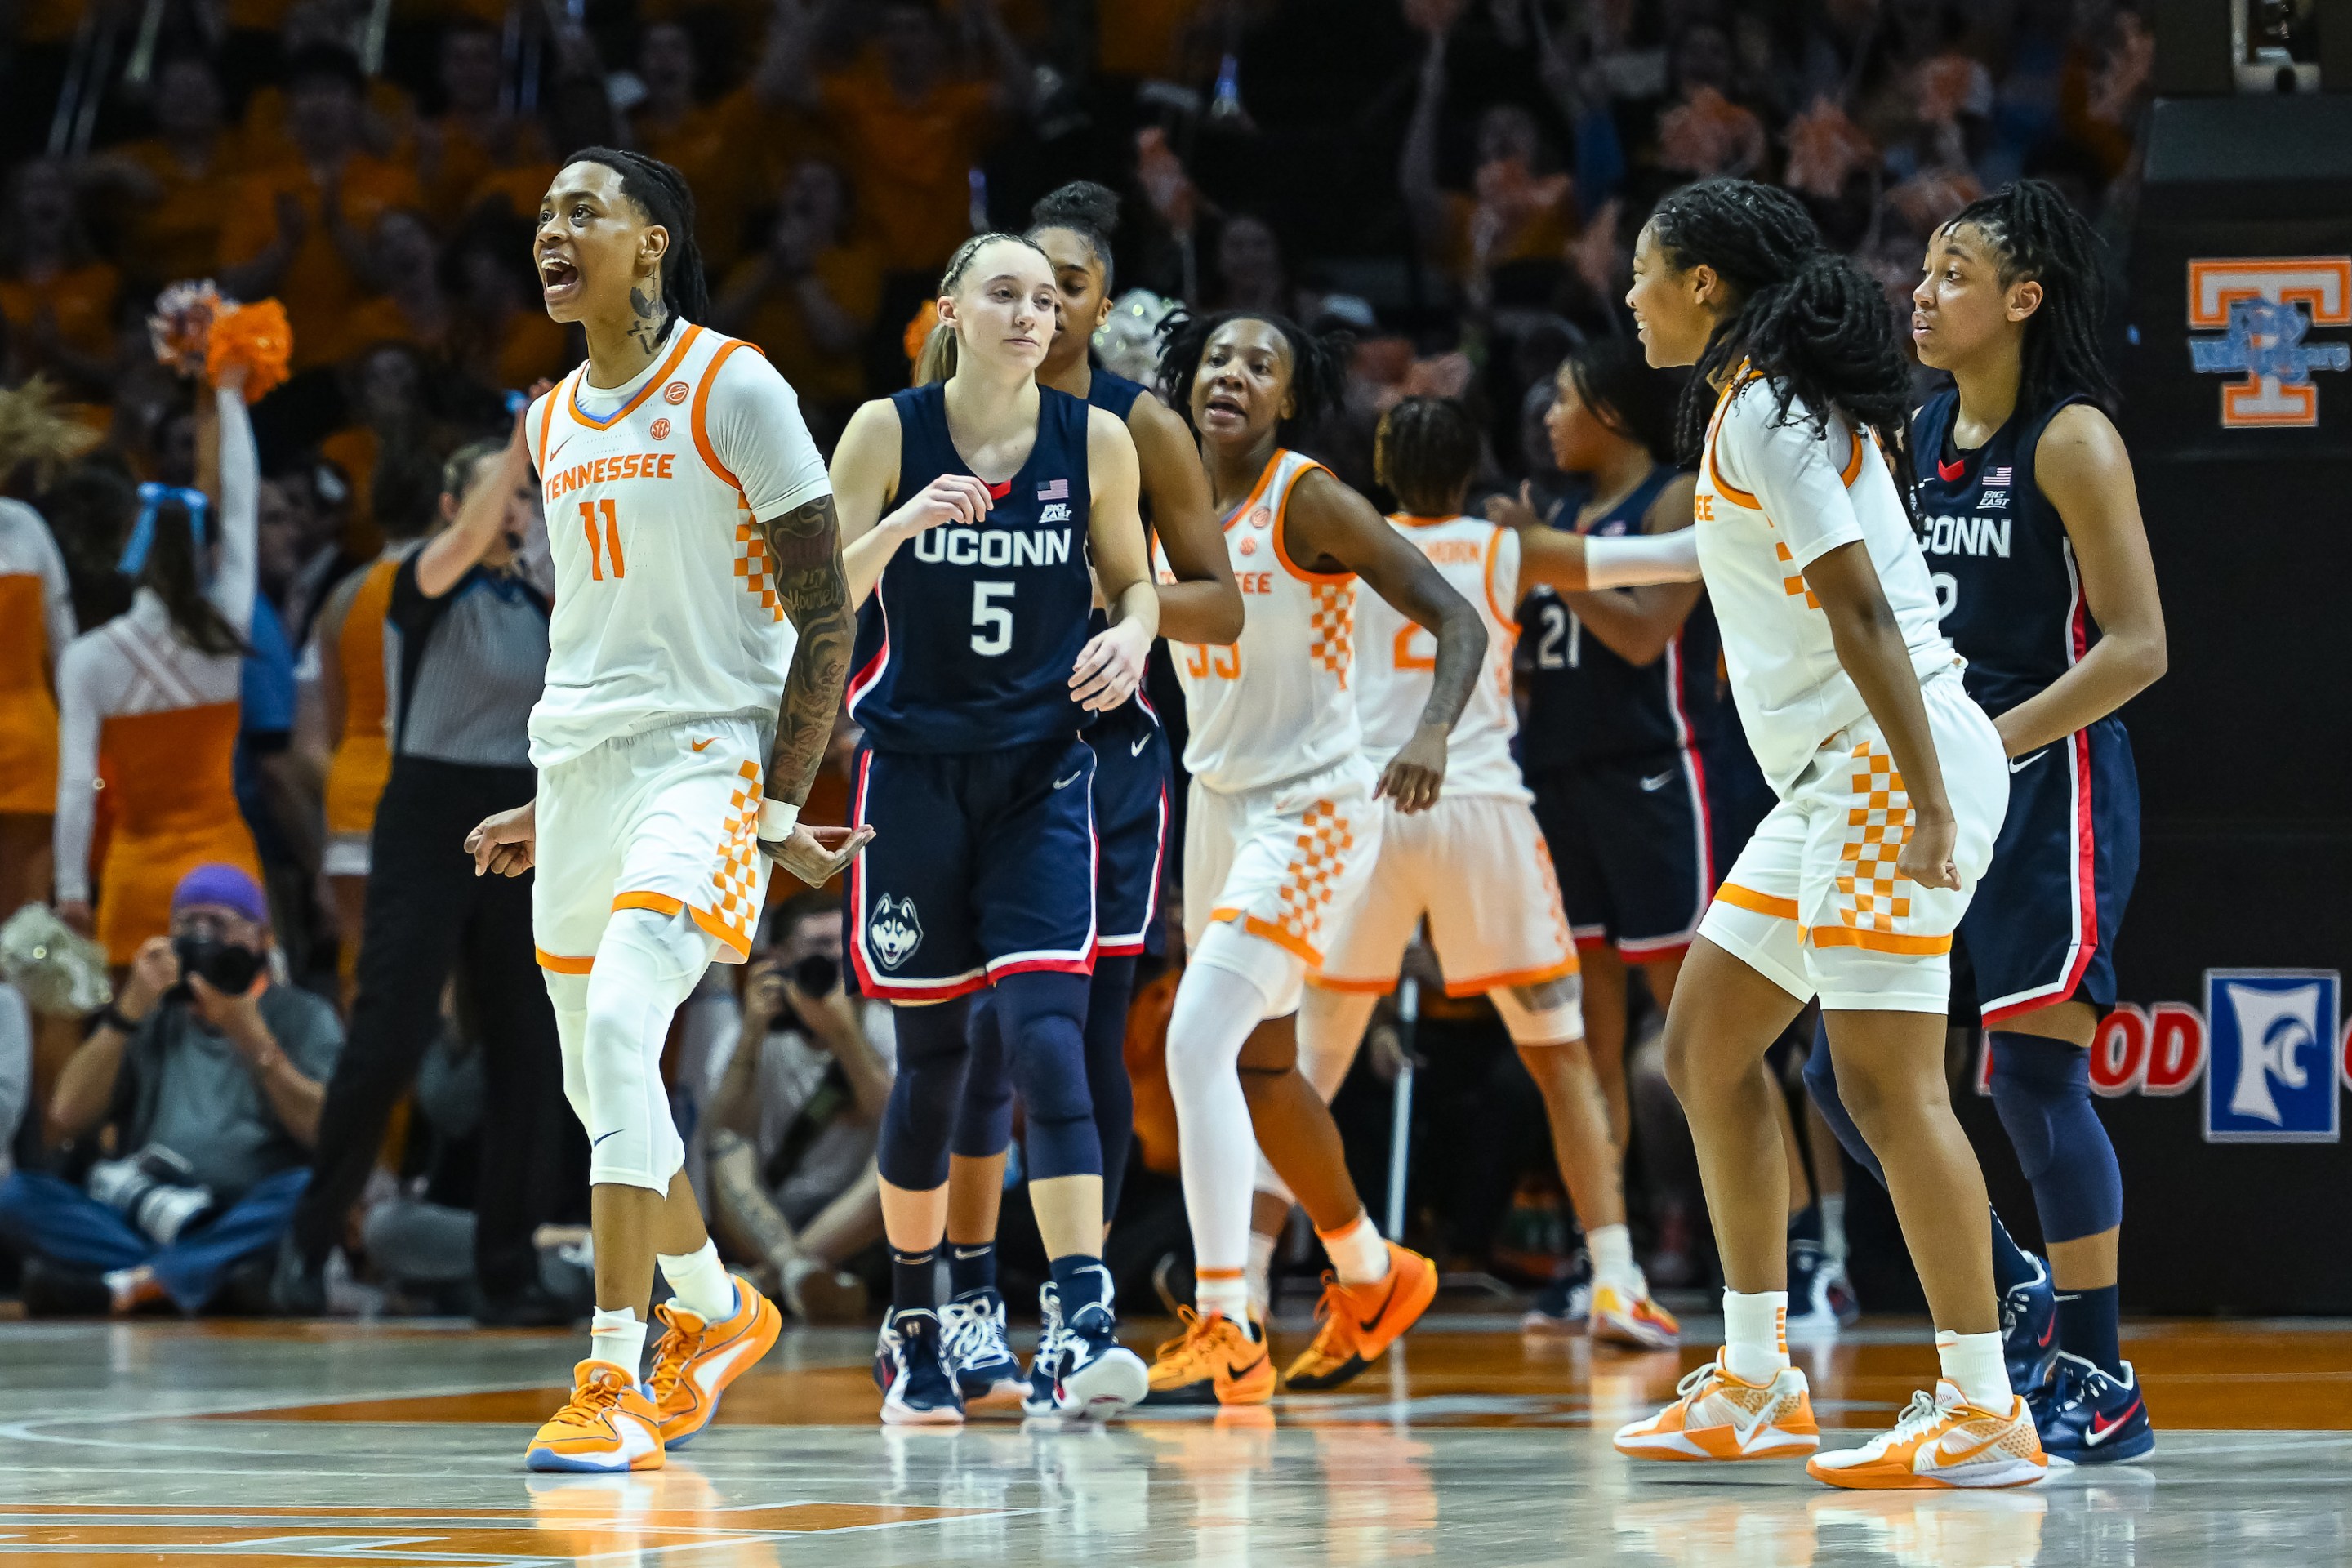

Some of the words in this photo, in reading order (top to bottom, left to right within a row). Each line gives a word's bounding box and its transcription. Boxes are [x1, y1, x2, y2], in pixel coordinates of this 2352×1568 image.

[545, 453, 677, 505] TENNESSEE
[1979, 498, 2011, 508] EAST
[1984, 491, 2007, 499] BIG
[579, 498, 625, 581] 11
[913, 528, 1072, 568] UCONN
[1918, 514, 2012, 559] CONN
[969, 580, 1017, 657] 5
[1537, 604, 1581, 670] 21
